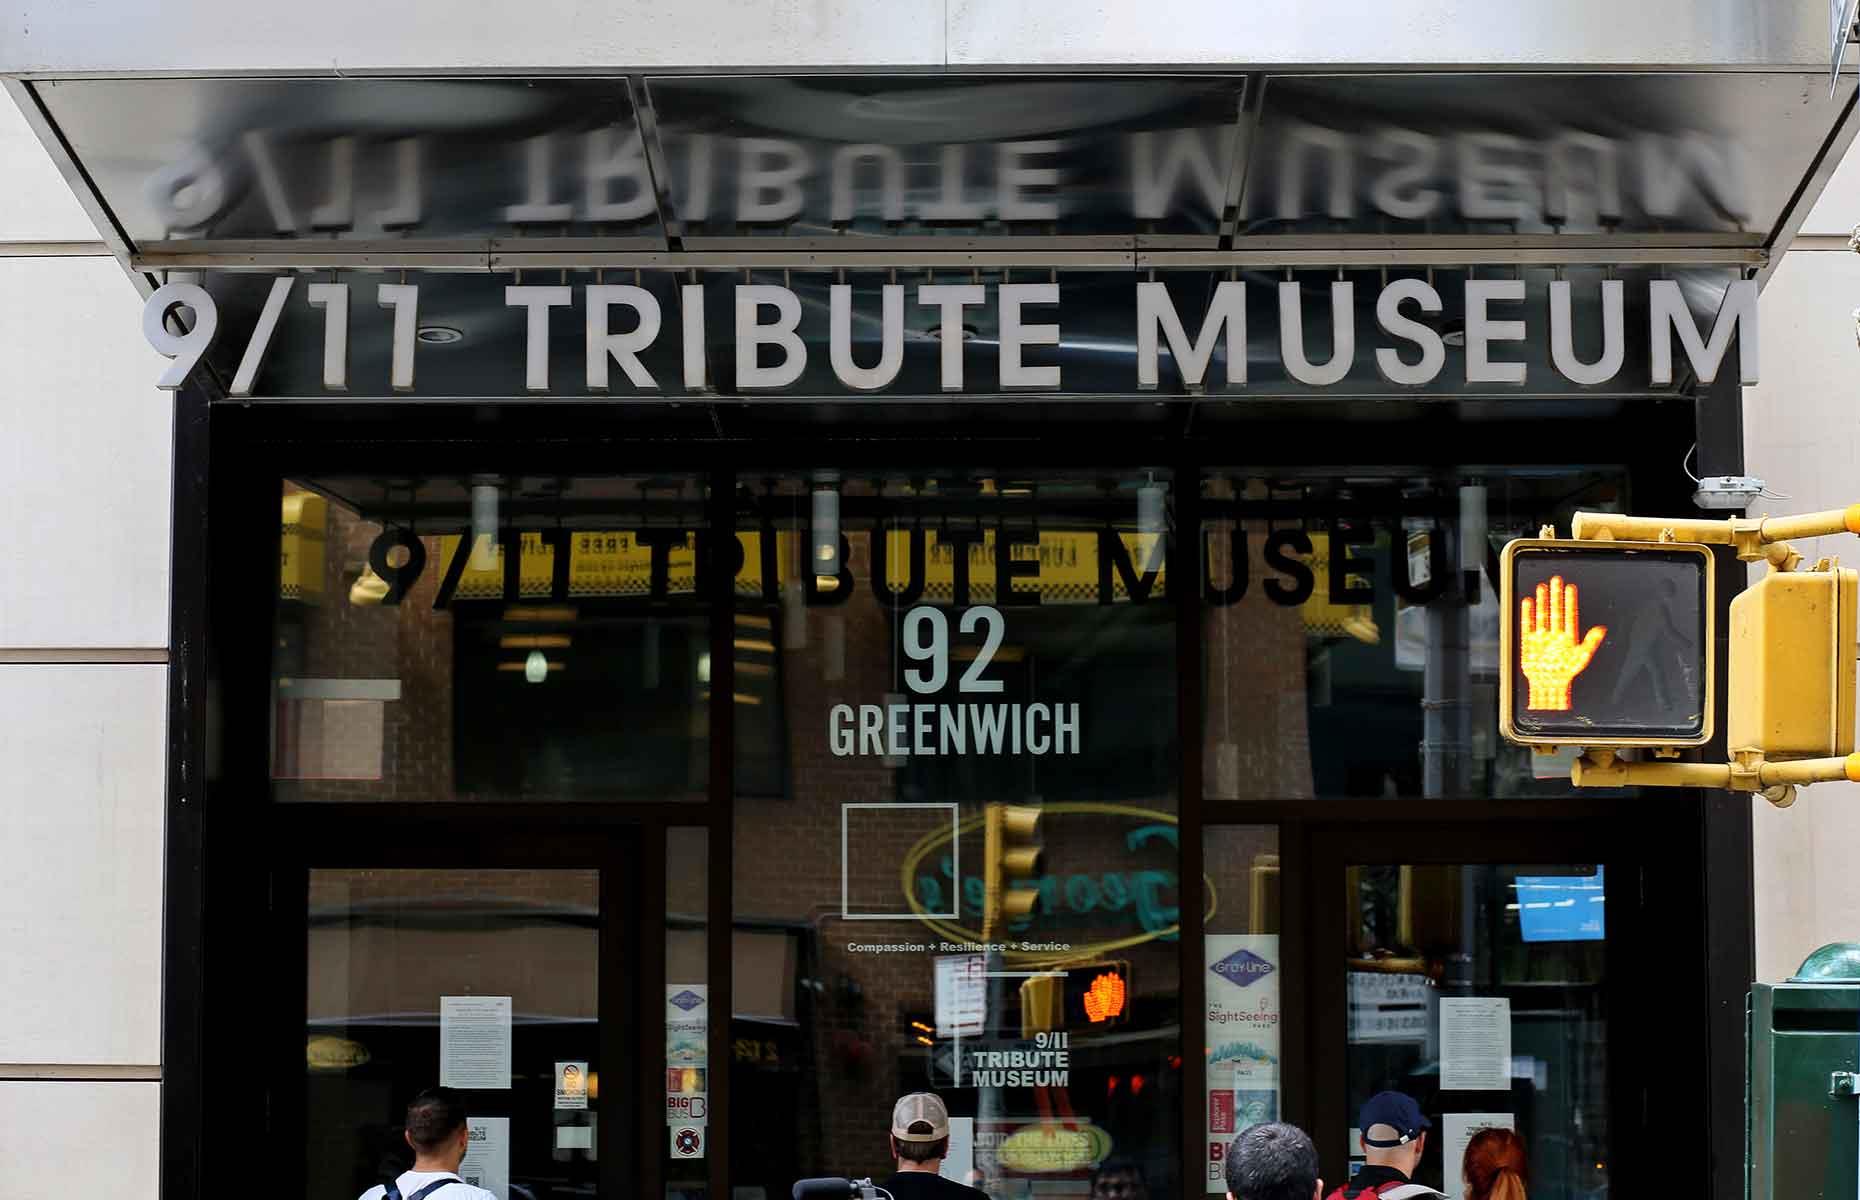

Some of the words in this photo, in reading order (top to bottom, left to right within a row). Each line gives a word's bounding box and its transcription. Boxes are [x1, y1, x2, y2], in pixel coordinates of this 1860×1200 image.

[142, 277, 420, 396] 9/11
[505, 284, 1062, 391] TRIBUTE
[1137, 278, 1759, 388] MUSEUM
[903, 605, 1006, 694] 92
[829, 702, 1081, 756] GREENWICH
[847, 942, 925, 955] Compassion
[940, 942, 1006, 952] Resilience
[1021, 942, 1070, 952] Service
[1208, 1011, 1278, 1024] SightSeeing
[973, 1051, 1069, 1068] TRIBUTE
[973, 1070, 1069, 1087] MUSEUM
[667, 1096, 689, 1108] BIG
